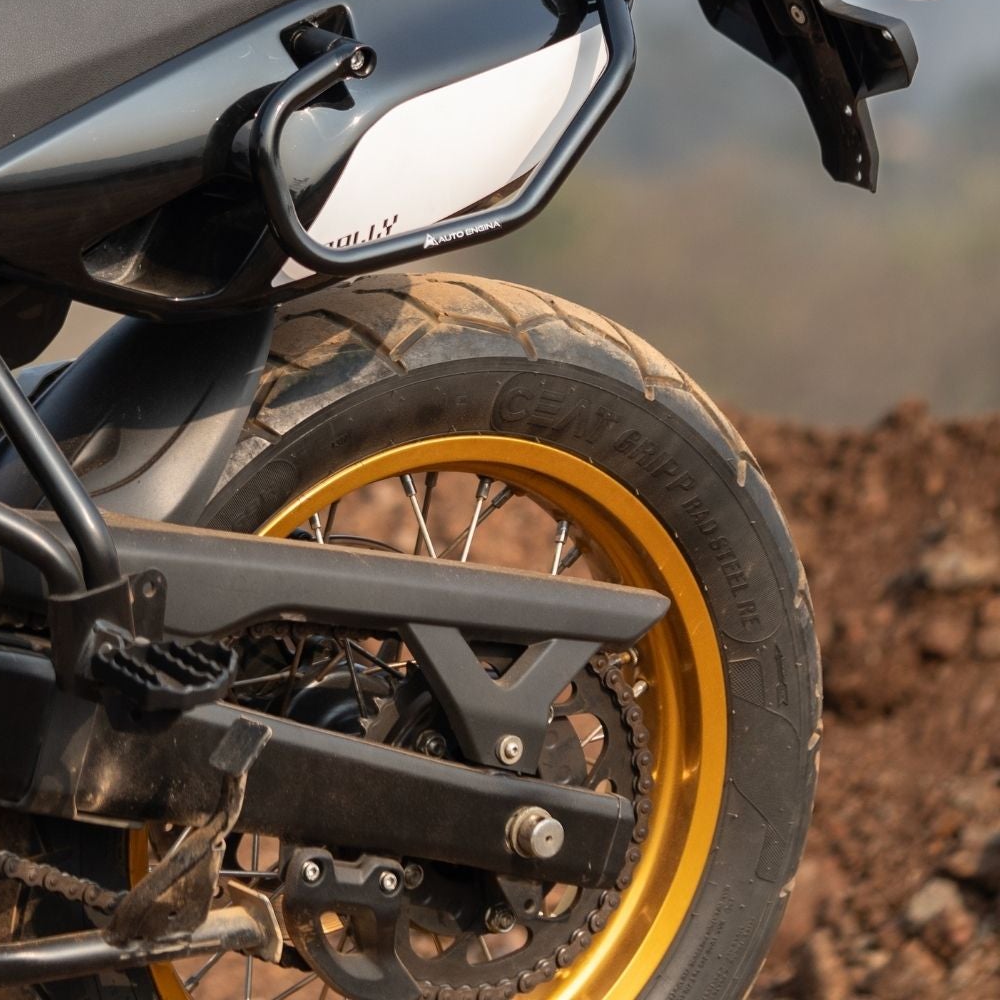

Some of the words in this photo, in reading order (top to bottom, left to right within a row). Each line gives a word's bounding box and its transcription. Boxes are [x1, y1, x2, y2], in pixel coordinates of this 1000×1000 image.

[328, 214, 398, 248] ALLY
[439, 230, 465, 243] AUTO
[465, 220, 501, 236] ENGINA
[499, 385, 618, 438] CEAT
[614, 429, 695, 491] GRIPP
